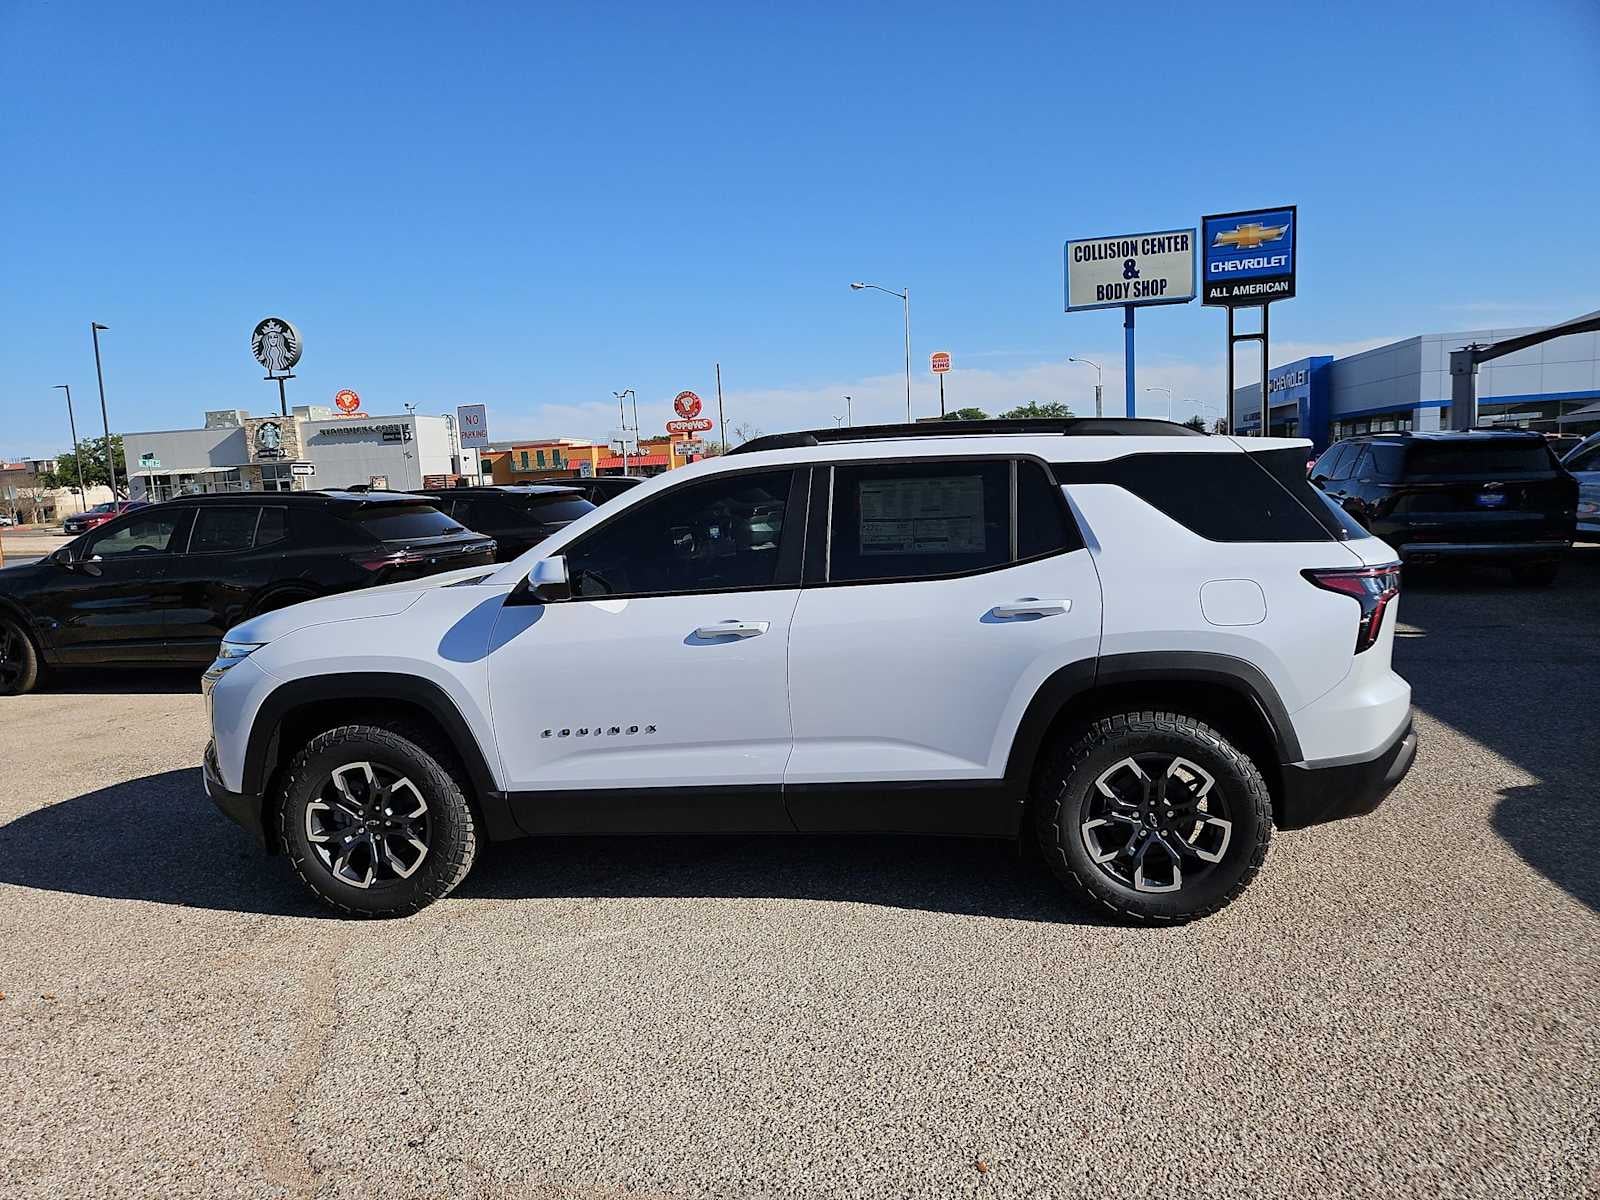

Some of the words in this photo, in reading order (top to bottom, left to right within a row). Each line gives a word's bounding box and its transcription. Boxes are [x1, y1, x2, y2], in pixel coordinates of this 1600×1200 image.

[1074, 239, 1138, 262] COLLISION
[1141, 234, 1189, 255] CENTER
[1122, 258, 1140, 280] &
[1210, 255, 1288, 273] CHEVROLET
[1096, 281, 1130, 301] BODY
[1133, 279, 1167, 297] SHOP
[1210, 287, 1230, 298] ALL
[1232, 281, 1289, 296] AMERICAN
[1273, 369, 1306, 392] CHEVROLET
[465, 415, 479, 425] NO
[461, 430, 487, 440] PARKING
[541, 725, 657, 738] EQUINOX
